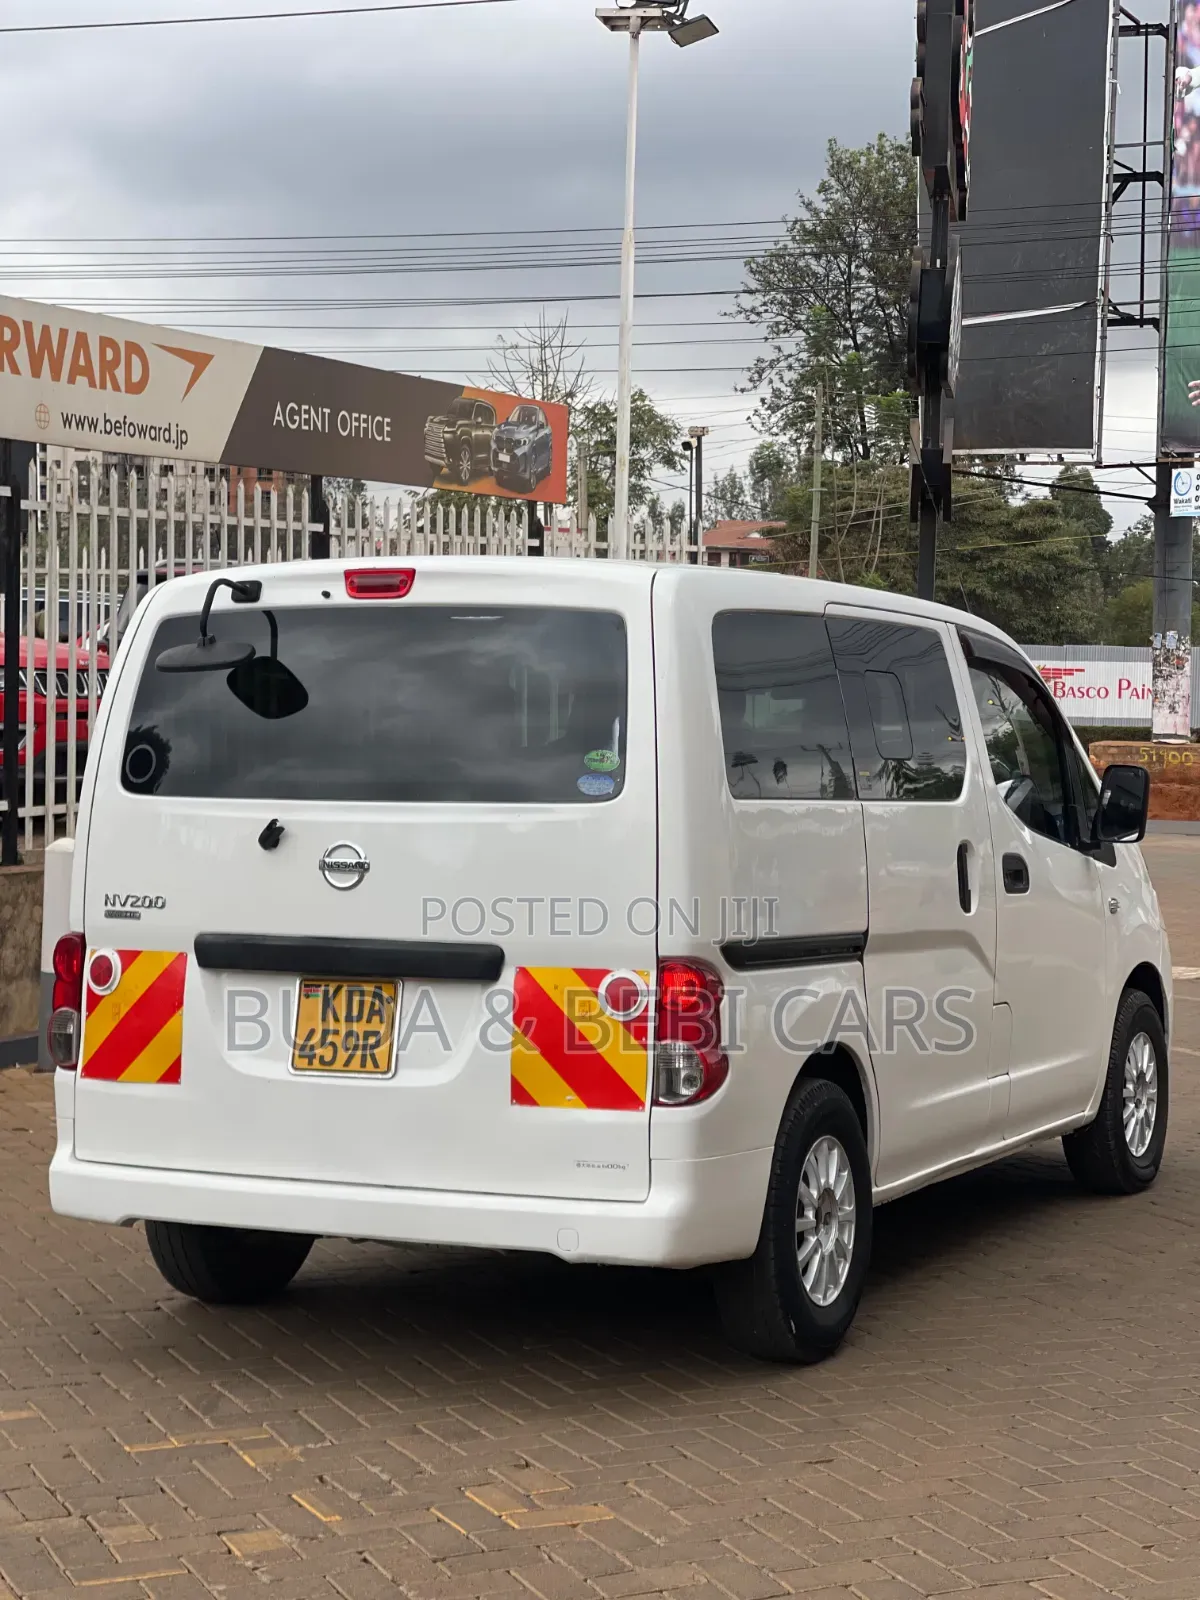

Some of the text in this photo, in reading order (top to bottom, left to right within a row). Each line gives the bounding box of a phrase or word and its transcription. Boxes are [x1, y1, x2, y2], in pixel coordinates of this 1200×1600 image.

[0, 314, 150, 395] RWARD
[61, 412, 188, 450] www.befoward.jp
[273, 401, 391, 441] AGENT OFFICE
[1053, 681, 1109, 699] BASCO
[322, 860, 366, 870] NISSAN
[104, 893, 166, 909] NV200
[321, 984, 386, 1024] KDA
[298, 1027, 382, 1068] 459R
